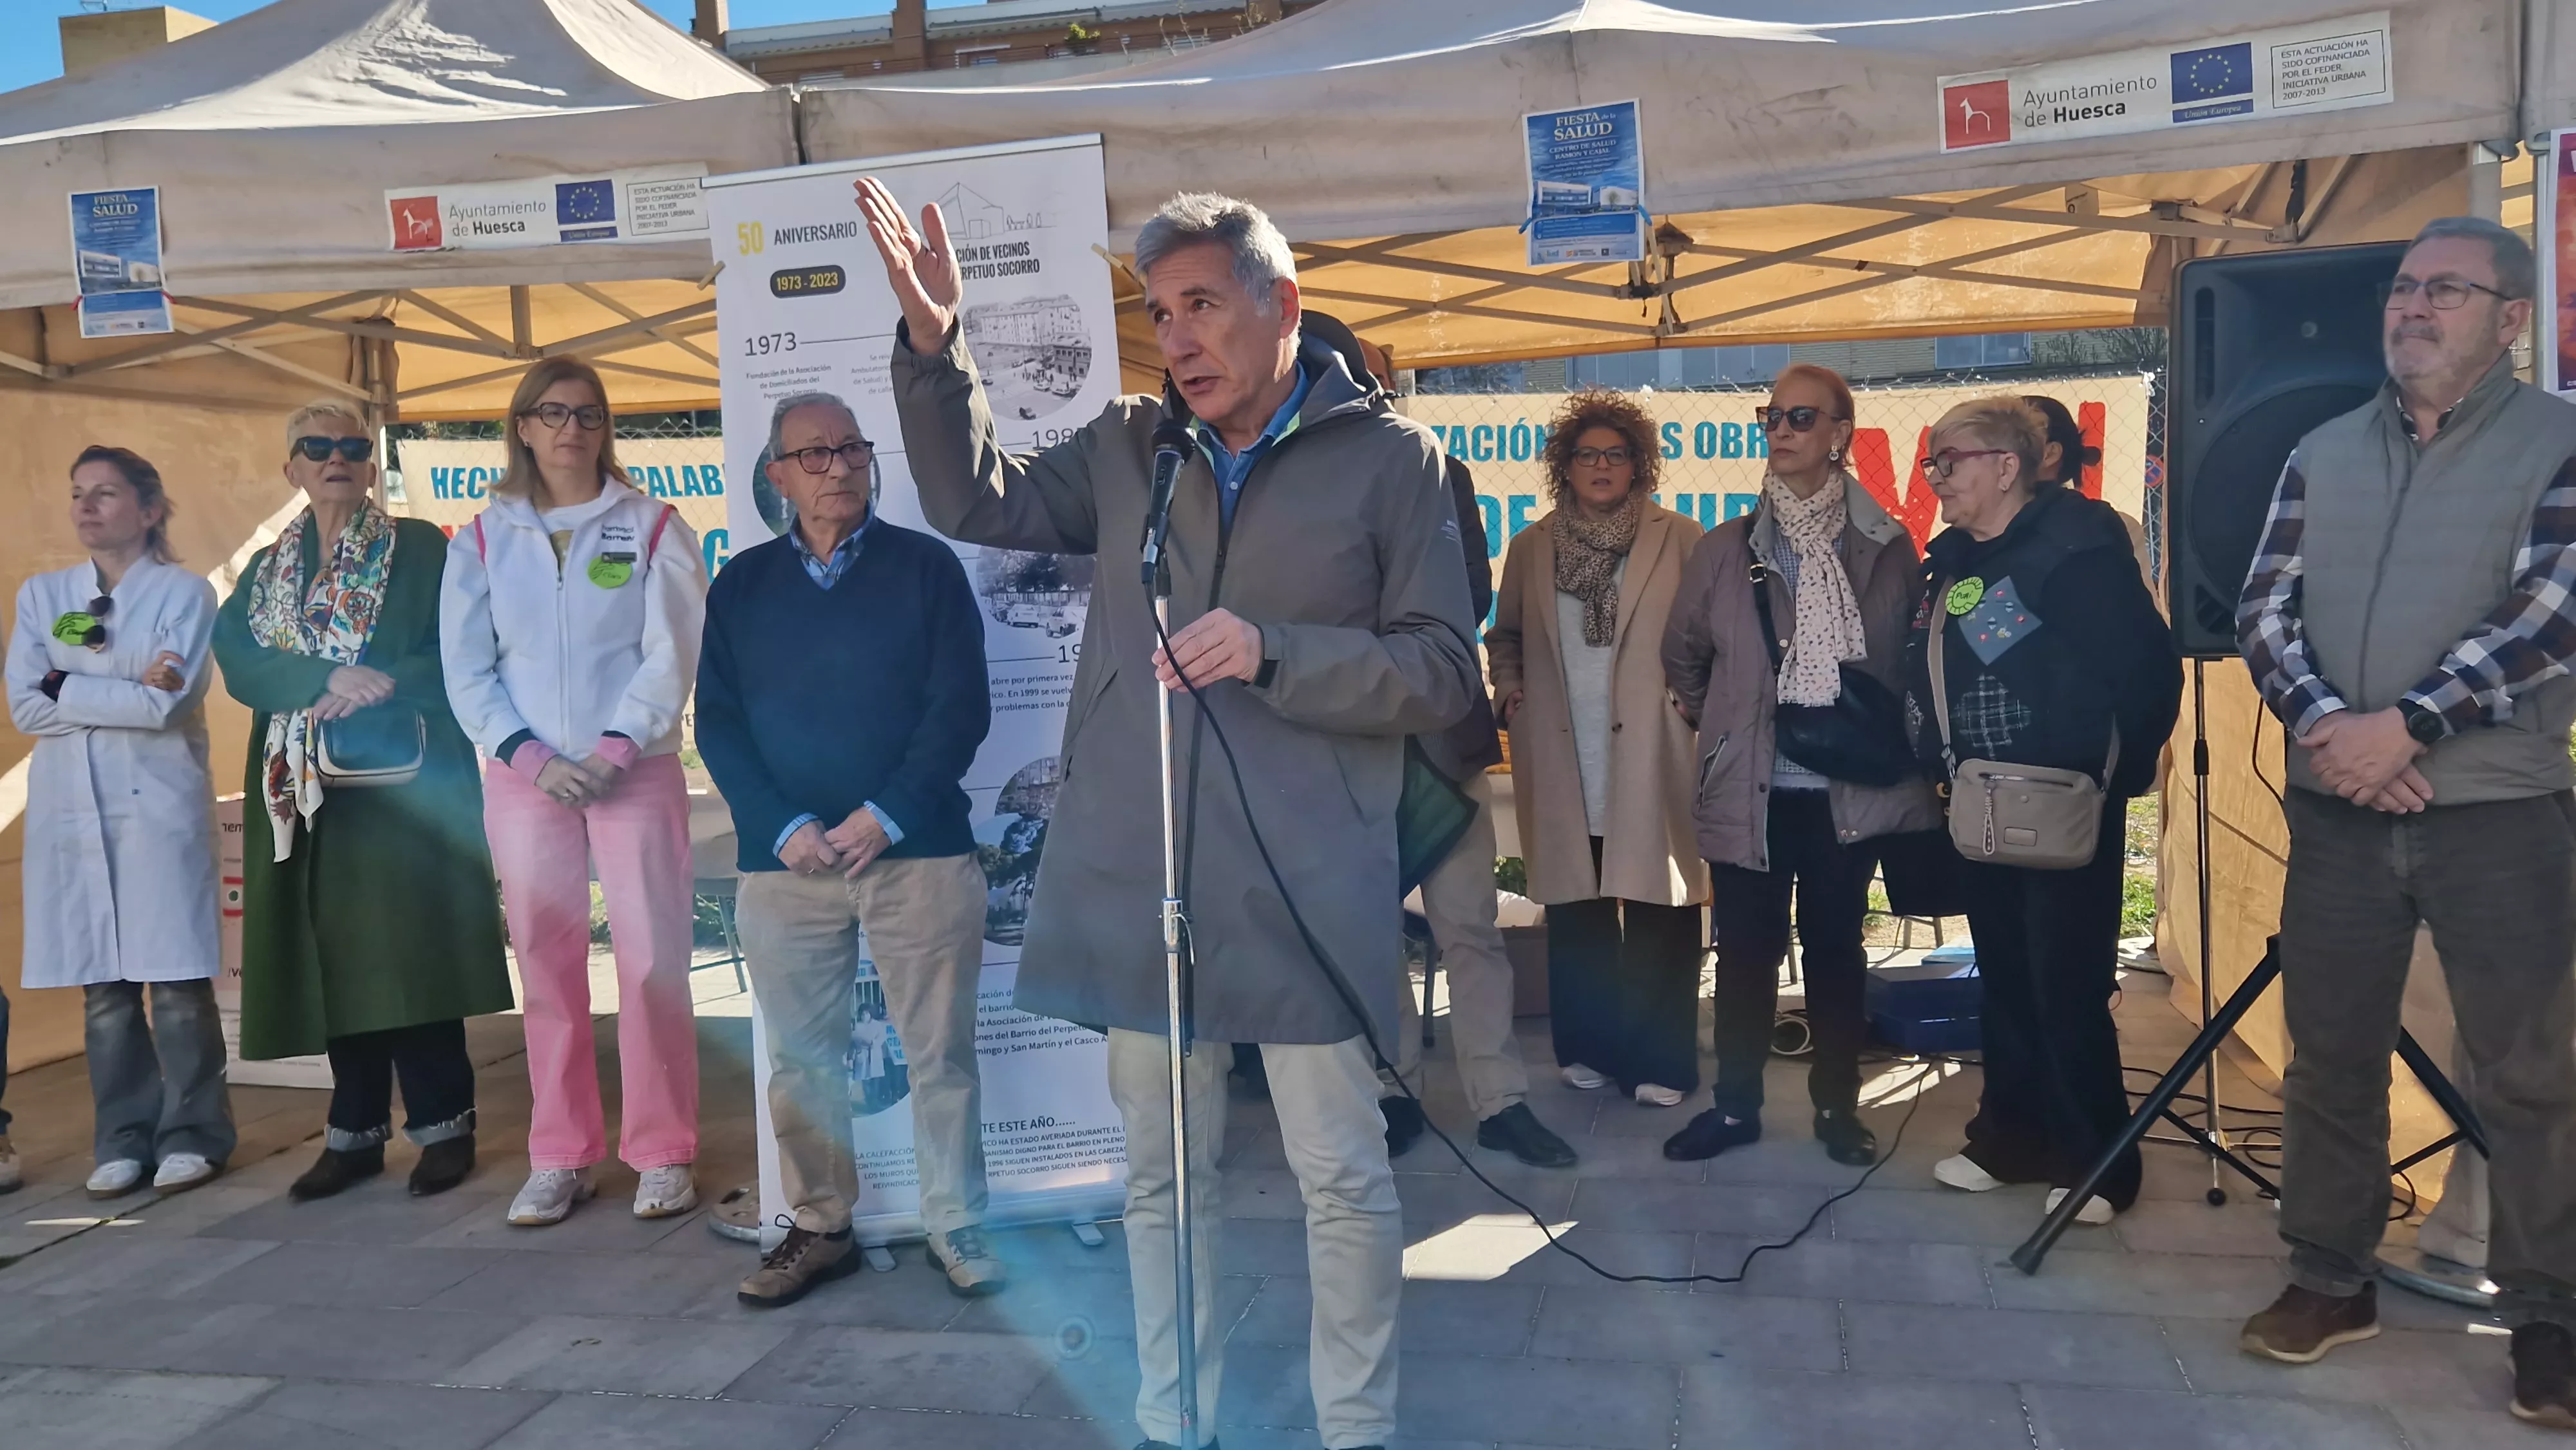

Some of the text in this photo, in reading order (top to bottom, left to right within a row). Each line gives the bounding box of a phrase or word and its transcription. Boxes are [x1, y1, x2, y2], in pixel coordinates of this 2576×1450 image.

[2281, 39, 2368, 59] ESTA ACTUACIÓN HA
[2282, 49, 2371, 69] SIDO COFINANCIADA
[2282, 70, 2300, 79] POR
[2315, 63, 2342, 75] FEDER
[2283, 71, 2367, 89] INICIATIVA URBANA
[2023, 77, 2157, 109] Ayuntamiento
[2283, 87, 2326, 100] 2007-2013
[1556, 112, 1600, 127] FIESTA
[2025, 102, 2126, 128] de Huesca
[1554, 122, 1613, 141] SALUD
[1549, 144, 1579, 154] CENTRO
[1592, 138, 1616, 148] SALUD
[93, 203, 138, 218] SALUD
[450, 200, 547, 222] Ayuntamiento
[452, 220, 526, 237] de Huesca
[737, 221, 857, 256] 50 ANIVERSARIO
[956, 241, 1030, 263] CIÓN DE VECINOS
[959, 258, 1040, 281] RPETUO SOCORRO
[777, 276, 801, 291] 1973
[810, 272, 838, 288] 2023
[745, 332, 797, 356] 1973
[746, 370, 780, 380] Fundación
[796, 363, 832, 374] Asociación
[769, 377, 808, 388] Domiciliados
[764, 390, 791, 400] Perpetuo
[1032, 428, 1074, 449] 198
[1694, 420, 1769, 460] OBR
[627, 464, 725, 497] PALAB
[1058, 643, 1081, 664] 19
[991, 677, 1009, 686] abre
[1011, 677, 1025, 686] por
[1027, 675, 1058, 685] primera
[1008, 690, 1018, 698] En
[1021, 688, 1039, 697] 1999
[1052, 686, 1072, 695] vuelv
[996, 702, 1039, 713] problemas
[976, 990, 1004, 1000] cación
[979, 1004, 1015, 1013] el barrio
[987, 1015, 1032, 1026] Asociación
[975, 1033, 994, 1042] ones
[995, 1031, 1009, 1040] del
[1011, 1028, 1036, 1039] Barrio
[1039, 1026, 1052, 1035] del
[976, 1048, 1003, 1057] mingo
[1004, 1046, 1009, 1055] y
[1011, 1044, 1027, 1053] San
[1029, 1040, 1056, 1050] Martín
[1065, 1038, 1072, 1046] el
[1075, 1037, 1099, 1045] Casco
[981, 1122, 996, 1133] TE
[999, 1120, 1028, 1133] ESTE
[1010, 1135, 1039, 1145] ESTADO
[1041, 1131, 1076, 1142] AVERIADA
[1077, 1127, 1111, 1138] DURANTE
[985, 1149, 1014, 1158] ANISMO
[1015, 1146, 1037, 1155] DIGNO
[1038, 1144, 1056, 1152] PARA
[1066, 1140, 1091, 1149] BARRIO
[1103, 1136, 1125, 1144] PLENO
[1005, 1158, 1030, 1166] SIGUEN
[1032, 1152, 1073, 1162] INSTALADOS
[864, 1172, 878, 1180] LOS
[879, 1170, 905, 1178] MUROS
[988, 1169, 1016, 1178] RPETUO
[1017, 1165, 1050, 1175] SOCORRO
[1051, 1162, 1076, 1171] SIGUEN
[1077, 1159, 1103, 1168] SIENDO
